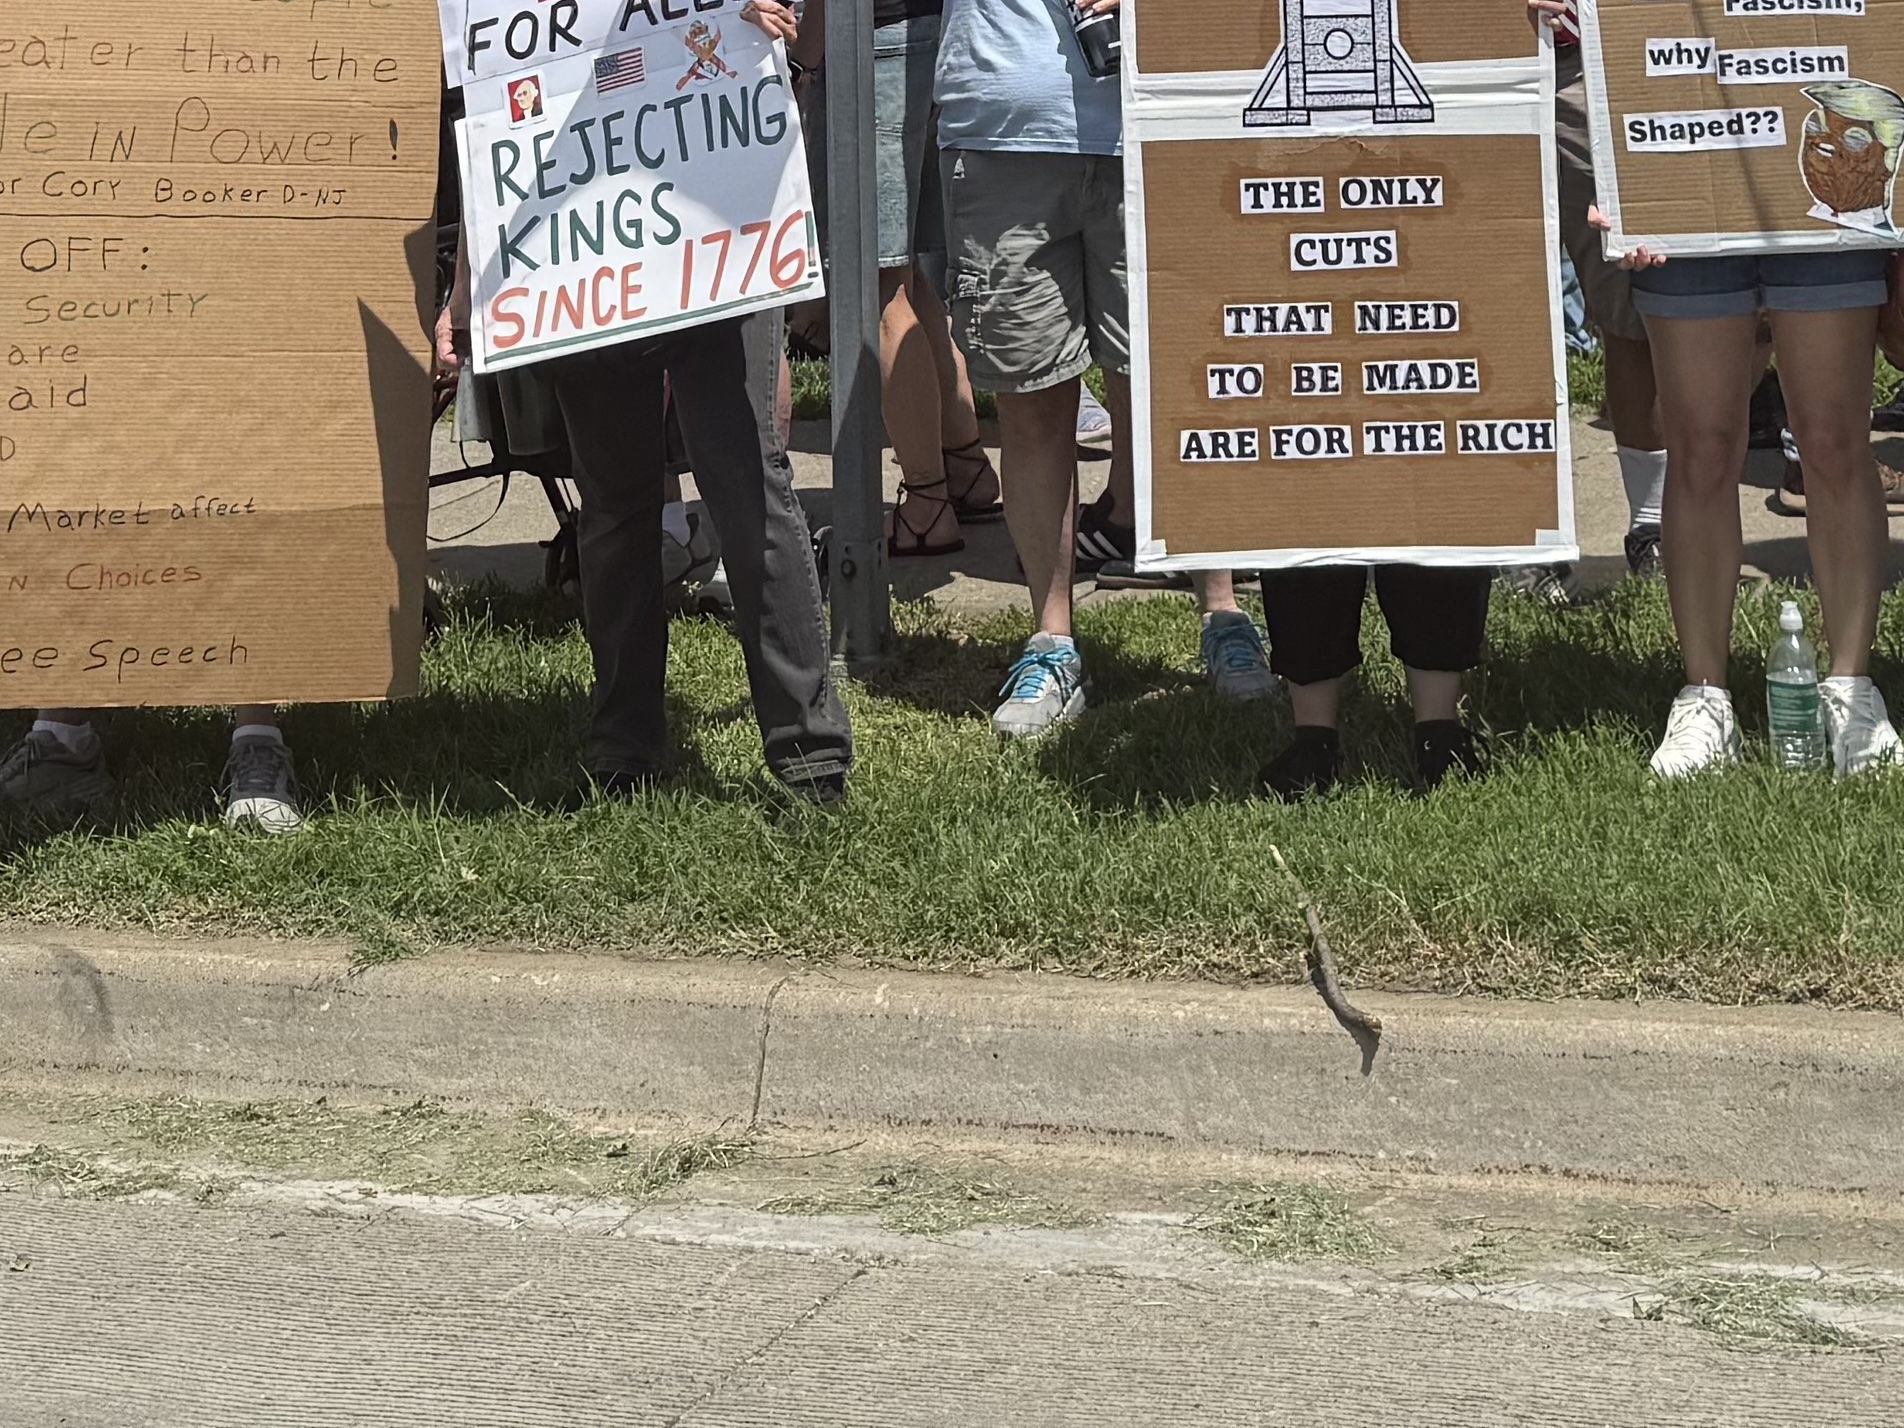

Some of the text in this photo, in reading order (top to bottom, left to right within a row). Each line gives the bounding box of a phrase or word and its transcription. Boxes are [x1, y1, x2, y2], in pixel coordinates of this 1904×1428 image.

[1649, 42, 1846, 77] why Fascism
[491, 74, 788, 207] REJECTING
[1628, 110, 1780, 145] Shaped??
[1244, 178, 1441, 209] THE ONLY
[498, 182, 682, 279] KINGS
[1294, 235, 1394, 267] CUTS
[491, 209, 820, 349] SINCE 1776!
[1226, 301, 1458, 334] THAT NEED
[1209, 361, 1478, 396] TO BE MADE
[1181, 421, 1554, 461] ARE FOR THE RICH
[66, 562, 203, 592] Choices
